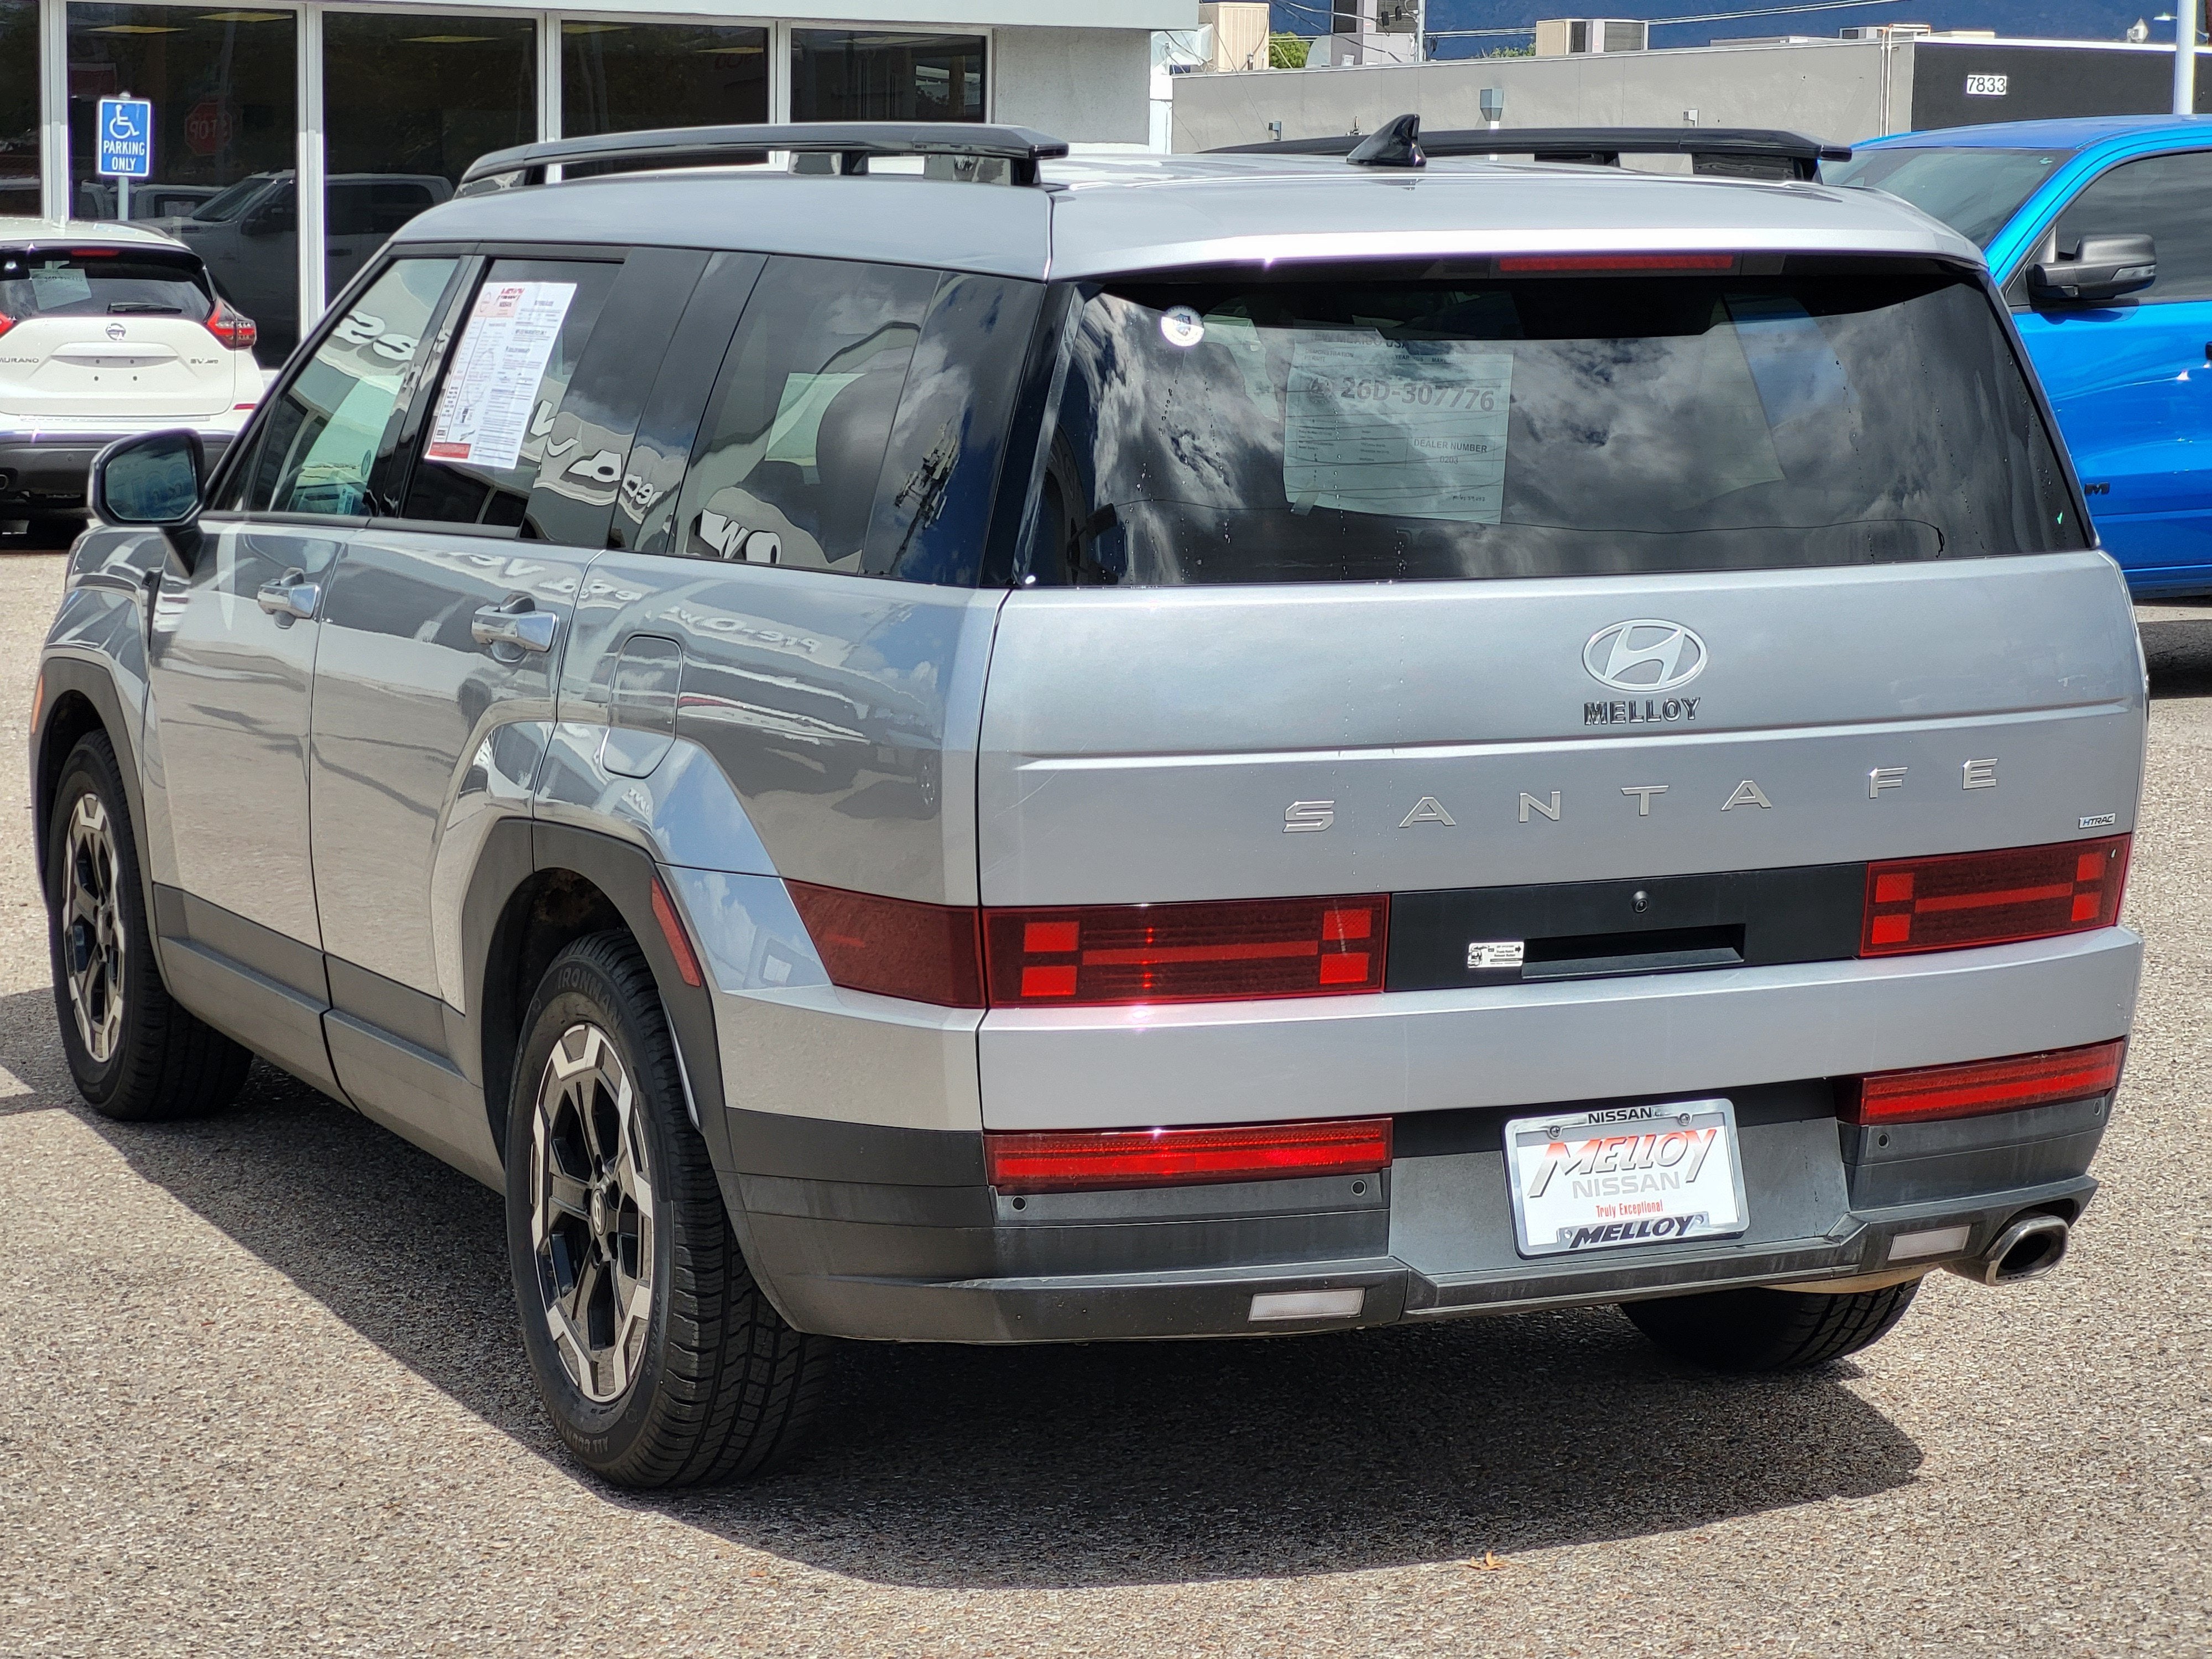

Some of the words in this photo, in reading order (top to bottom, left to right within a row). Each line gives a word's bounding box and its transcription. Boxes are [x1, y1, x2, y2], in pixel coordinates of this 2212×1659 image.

[1968, 77, 2006, 92] 7833
[103, 140, 145, 156] PARKING
[112, 157, 136, 171] ONLY
[1340, 376, 1495, 411] 26D-307776
[1413, 439, 1448, 450] DEALER
[1450, 442, 1488, 453] NUMBER
[1584, 697, 1701, 726] MELLOY
[1283, 779, 1772, 833] SANTA
[1869, 758, 1999, 799] FE
[2082, 816, 2114, 826] HTRAC
[557, 967, 623, 1030] IRONMAN
[1588, 1107, 1652, 1124] NISSAN
[1527, 1128, 1718, 1199] MELLOY
[1572, 1171, 1681, 1199] NISSAN
[1596, 1203, 1616, 1218] Truly
[1619, 1199, 1664, 1216] Exceptional
[1569, 1215, 1695, 1249] MELLOY
